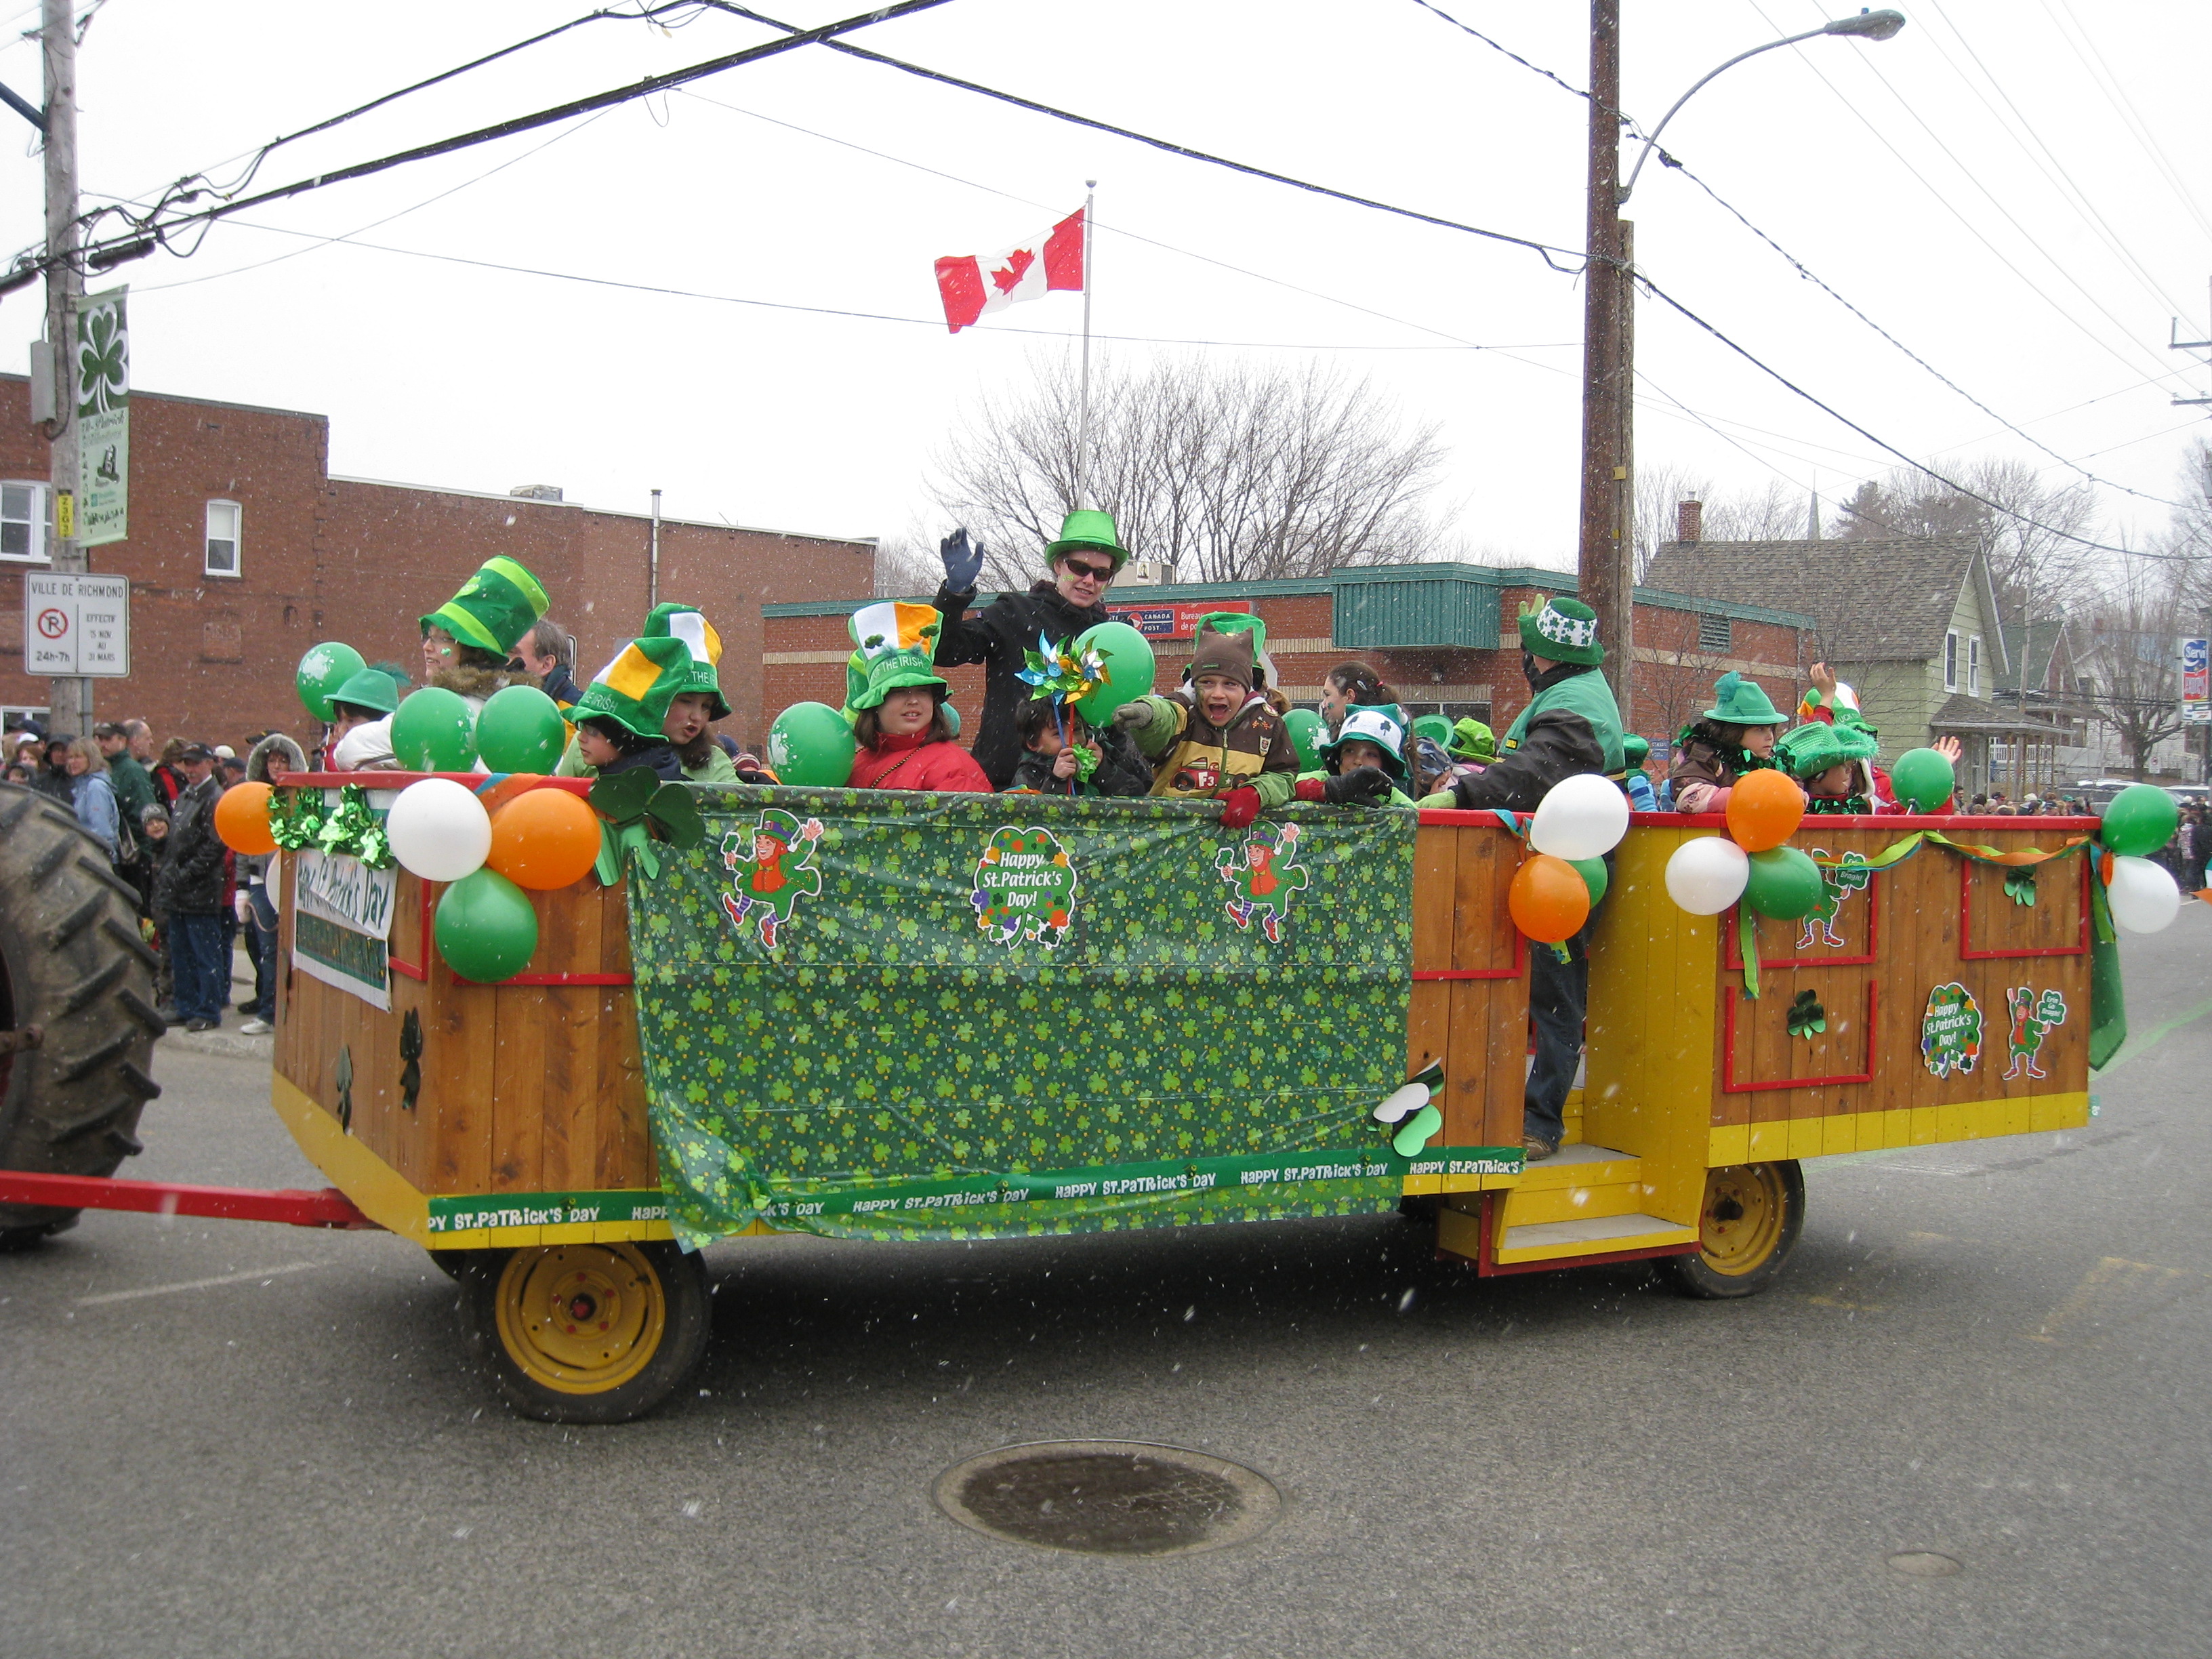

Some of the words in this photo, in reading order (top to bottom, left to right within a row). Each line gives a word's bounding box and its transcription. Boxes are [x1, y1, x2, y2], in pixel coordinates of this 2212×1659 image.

[31, 582, 57, 595] VILLE
[62, 583, 73, 596] DE
[79, 584, 124, 598] RICHMOND
[86, 614, 116, 623] EFFECTIF
[1181, 621, 1189, 630] de
[37, 651, 70, 662] 24h-7h
[98, 653, 115, 661] MARS
[881, 657, 899, 673] THE
[899, 655, 924, 668] IRISH
[691, 671, 710, 684] THE
[591, 693, 619, 714] IRISH
[1835, 713, 1853, 724] LUCK
[1000, 852, 1044, 869] Happy
[983, 870, 1063, 888] St.Patrick's
[1840, 871, 1863, 882] Bragh!
[1007, 890, 1038, 909] Day!
[1934, 1002, 1959, 1018] Happy
[1926, 1014, 1972, 1036] St.Patrick's
[1939, 1031, 1957, 1046] Day!
